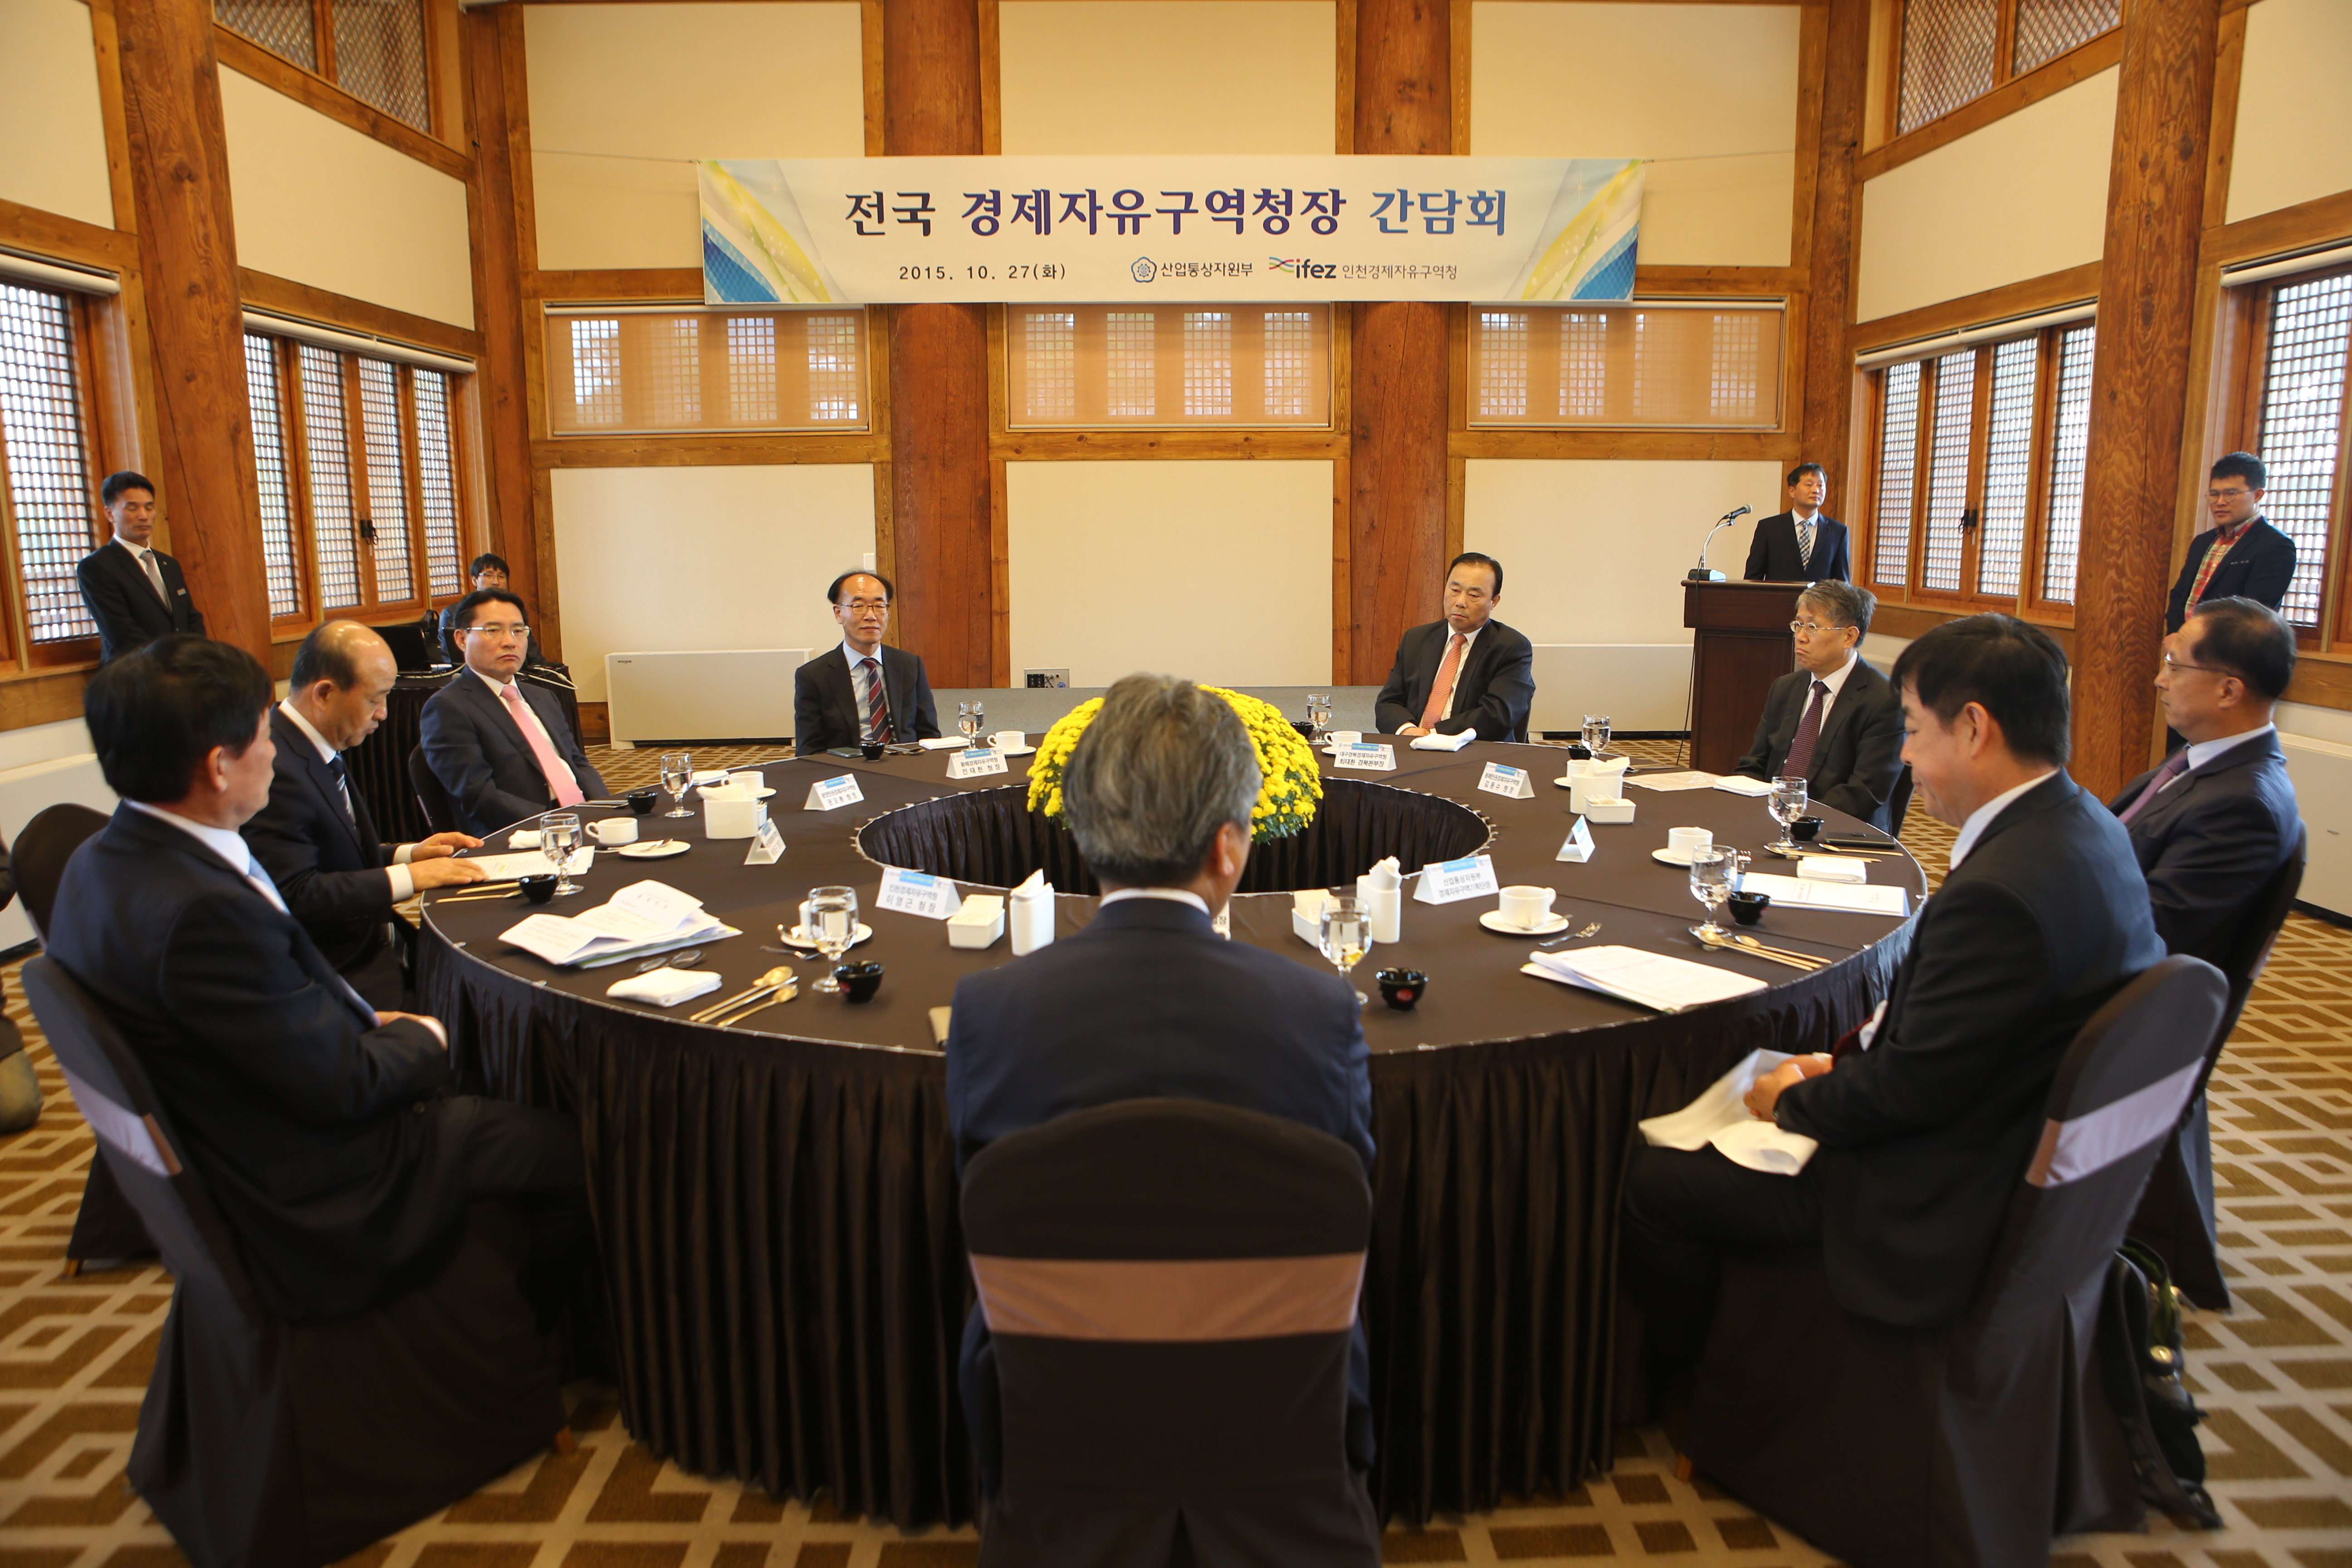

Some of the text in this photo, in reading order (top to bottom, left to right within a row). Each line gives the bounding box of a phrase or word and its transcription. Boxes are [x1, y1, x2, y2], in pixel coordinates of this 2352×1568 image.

[845, 188, 1506, 236] 전국 경제자유구역청장 간담회
[899, 264, 1065, 280] 2015. 10. 27(화)
[1161, 262, 1253, 277] 산업통상자원부
[1296, 258, 1337, 279] ifez
[1343, 265, 1457, 279] 인천경제자유구역청
[1443, 872, 1481, 886] 산업통상자원부
